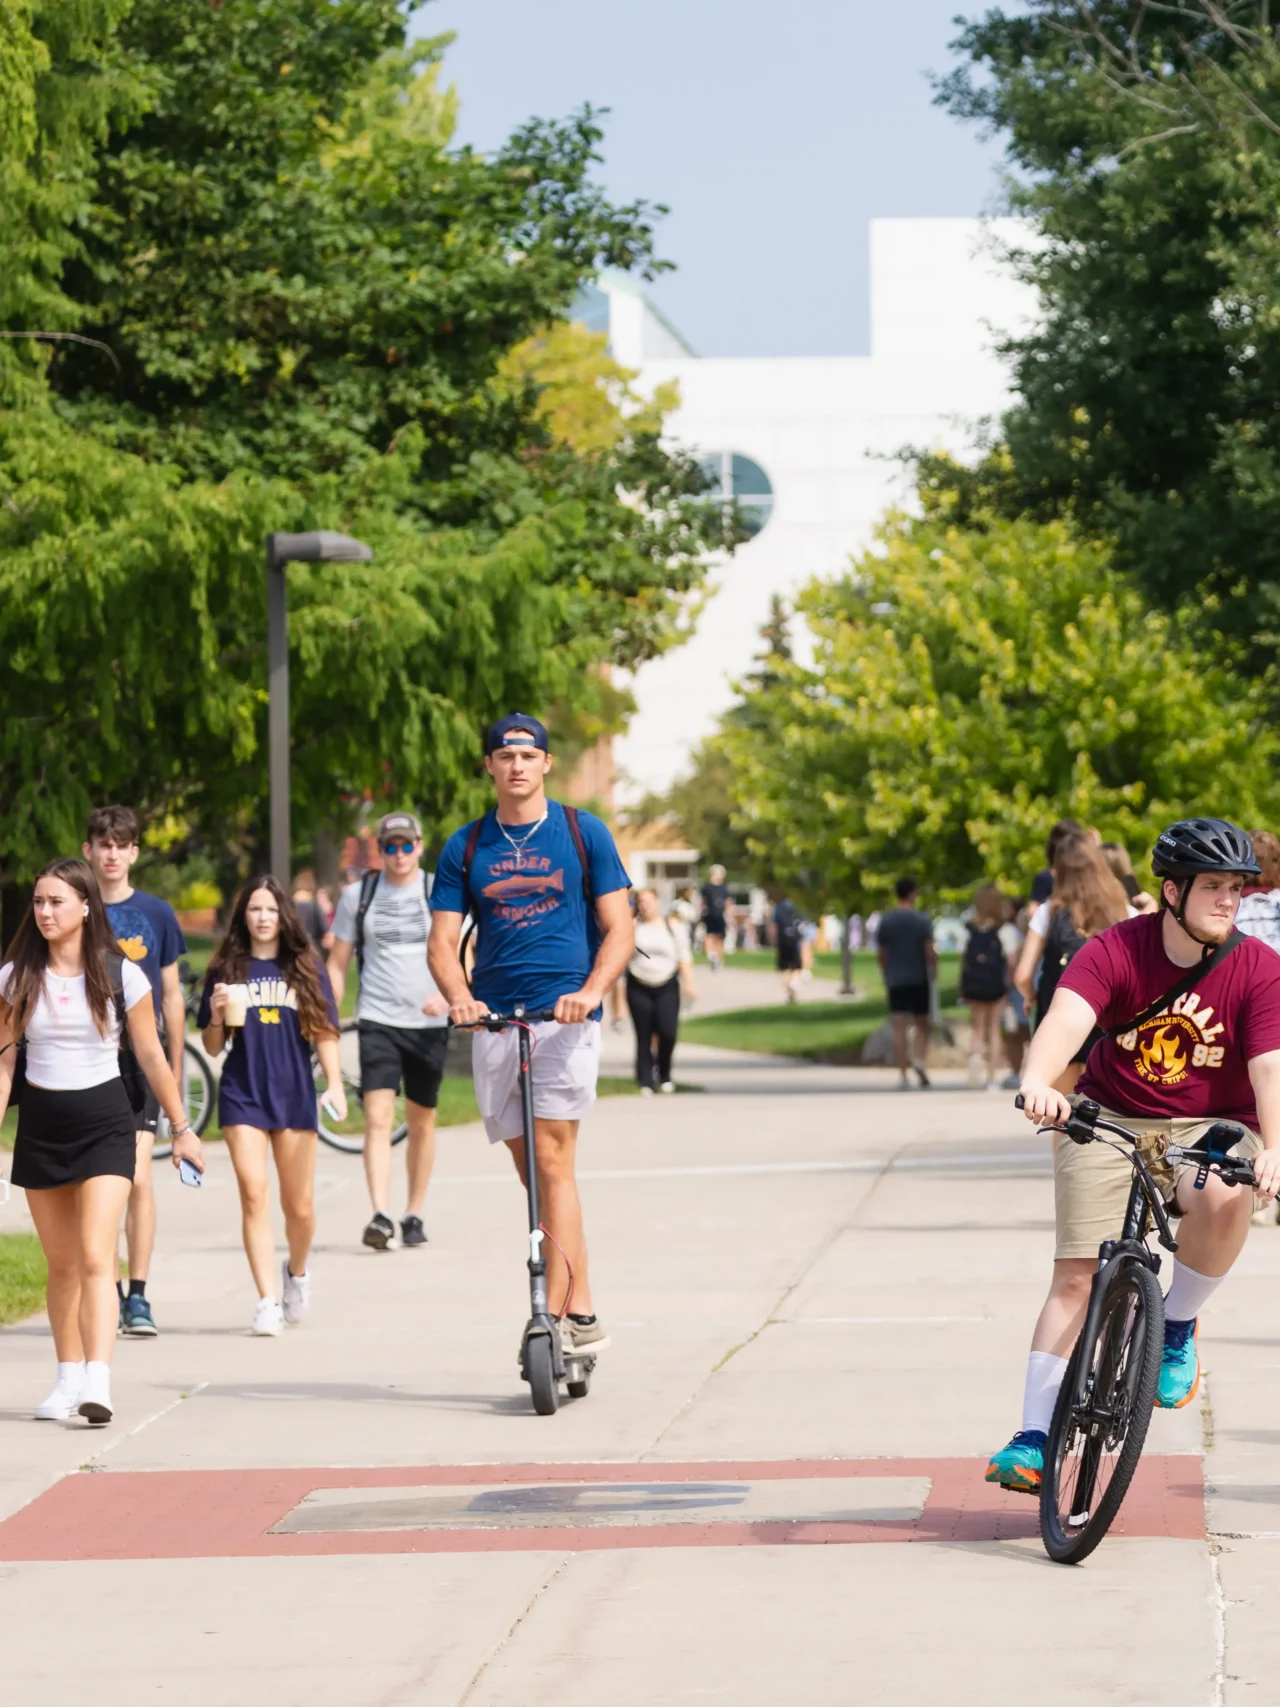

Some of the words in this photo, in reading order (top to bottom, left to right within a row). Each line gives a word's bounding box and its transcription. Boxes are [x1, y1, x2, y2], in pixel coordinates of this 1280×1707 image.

[489, 856, 551, 876] UNDER
[1191, 1044, 1225, 1068] 92
[1134, 1058, 1148, 1077] FIRE
[1147, 1073, 1159, 1083] UP
